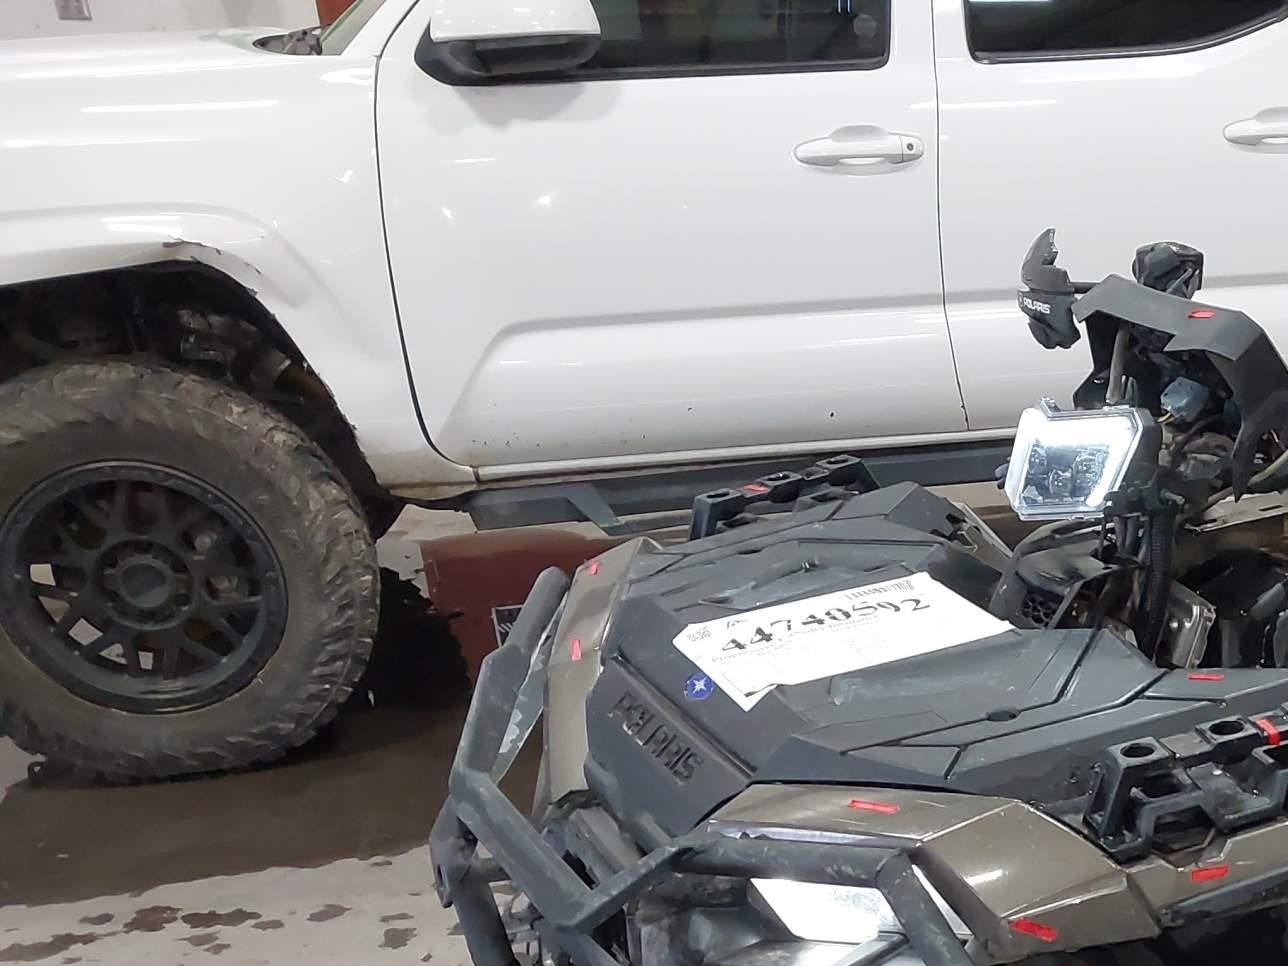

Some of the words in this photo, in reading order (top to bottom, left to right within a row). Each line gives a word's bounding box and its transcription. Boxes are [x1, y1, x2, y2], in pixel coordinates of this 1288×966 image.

[1023, 297, 1052, 315] POLARIS
[722, 598, 931, 651] 44740592
[607, 691, 705, 786] POLARIS
